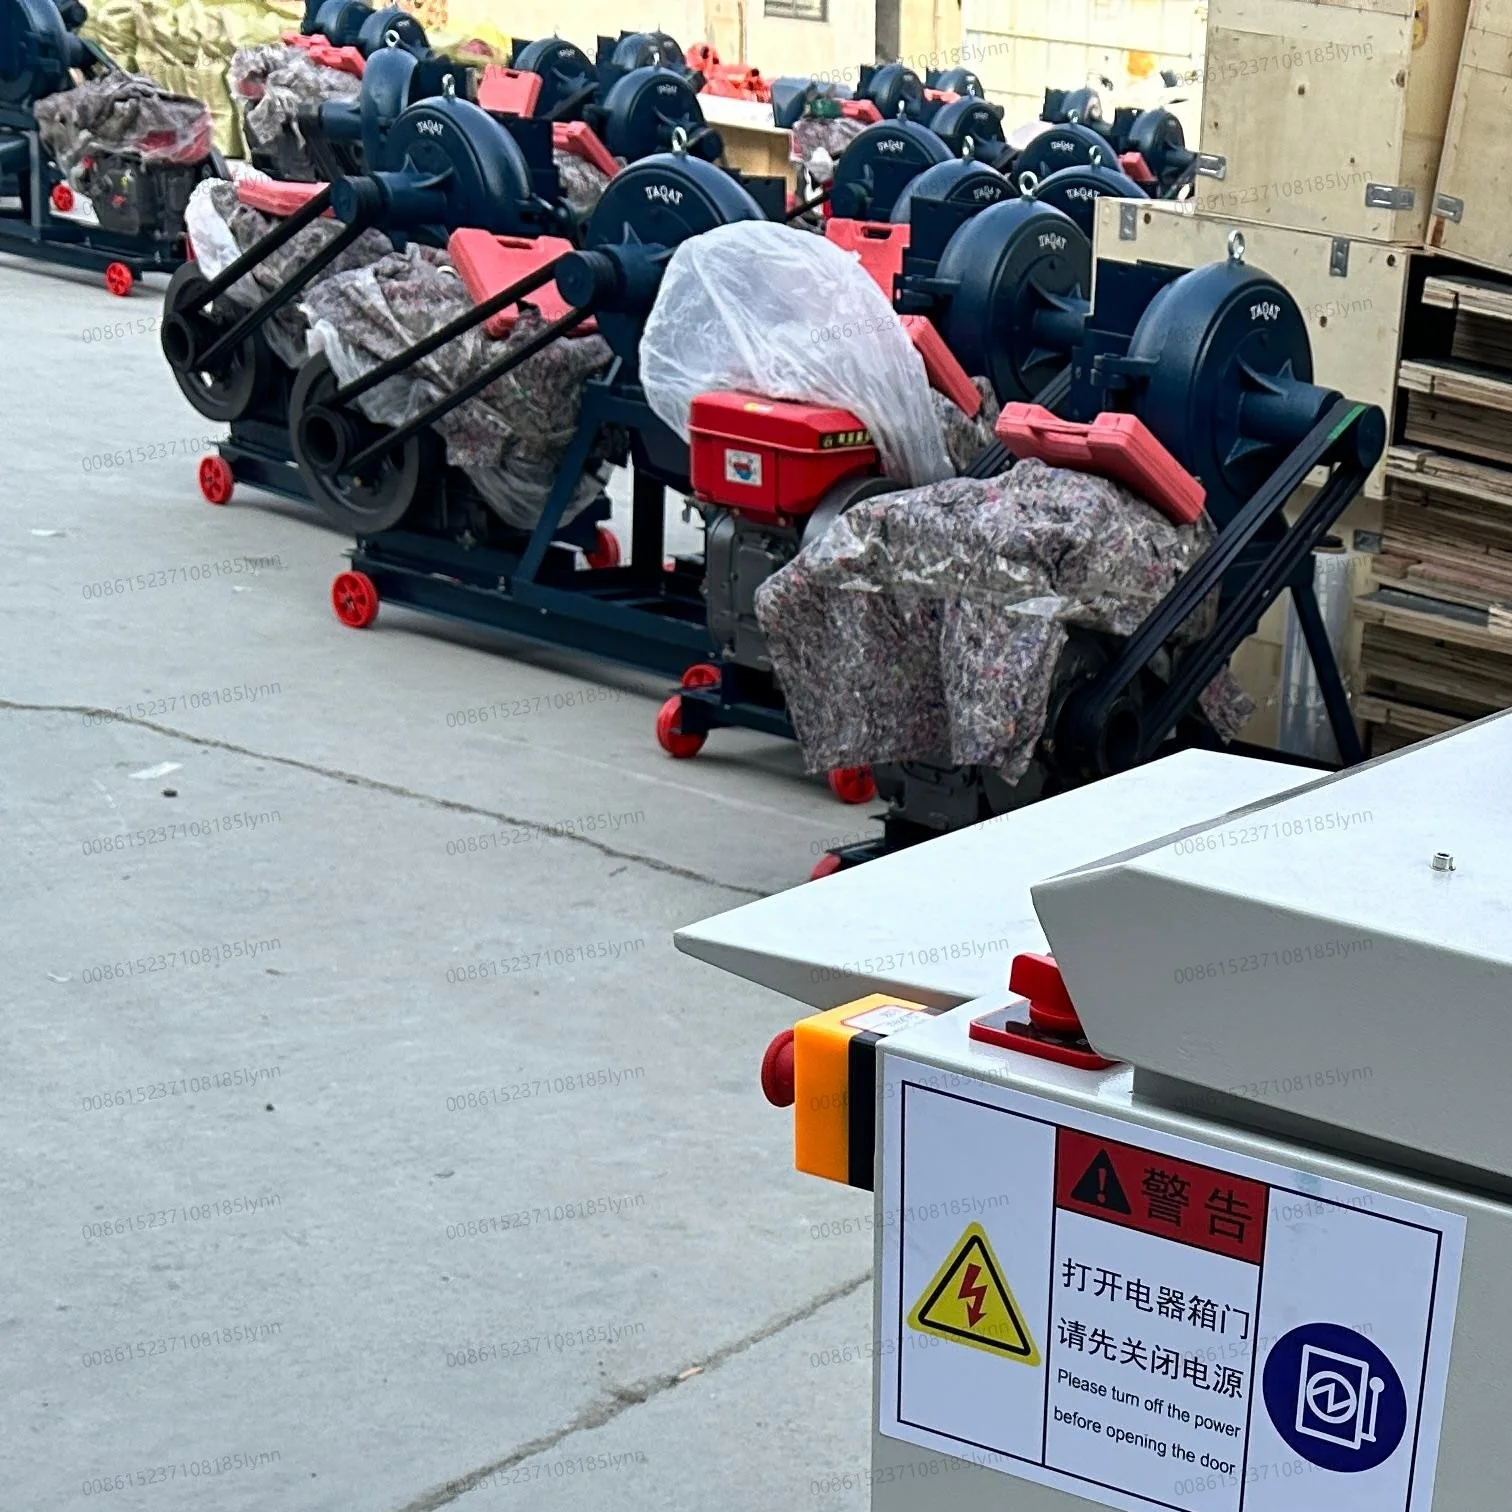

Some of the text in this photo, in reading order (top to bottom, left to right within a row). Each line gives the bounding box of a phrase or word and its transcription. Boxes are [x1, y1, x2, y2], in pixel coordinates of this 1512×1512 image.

[1141, 1167, 1253, 1244] 警告
[1061, 1258, 1250, 1340] 打开电器箱门
[1057, 1317, 1244, 1399] 请先关闭电源
[1054, 1406, 1236, 1475] before opening the door
[1058, 1368, 1242, 1438] Please turn off the power
